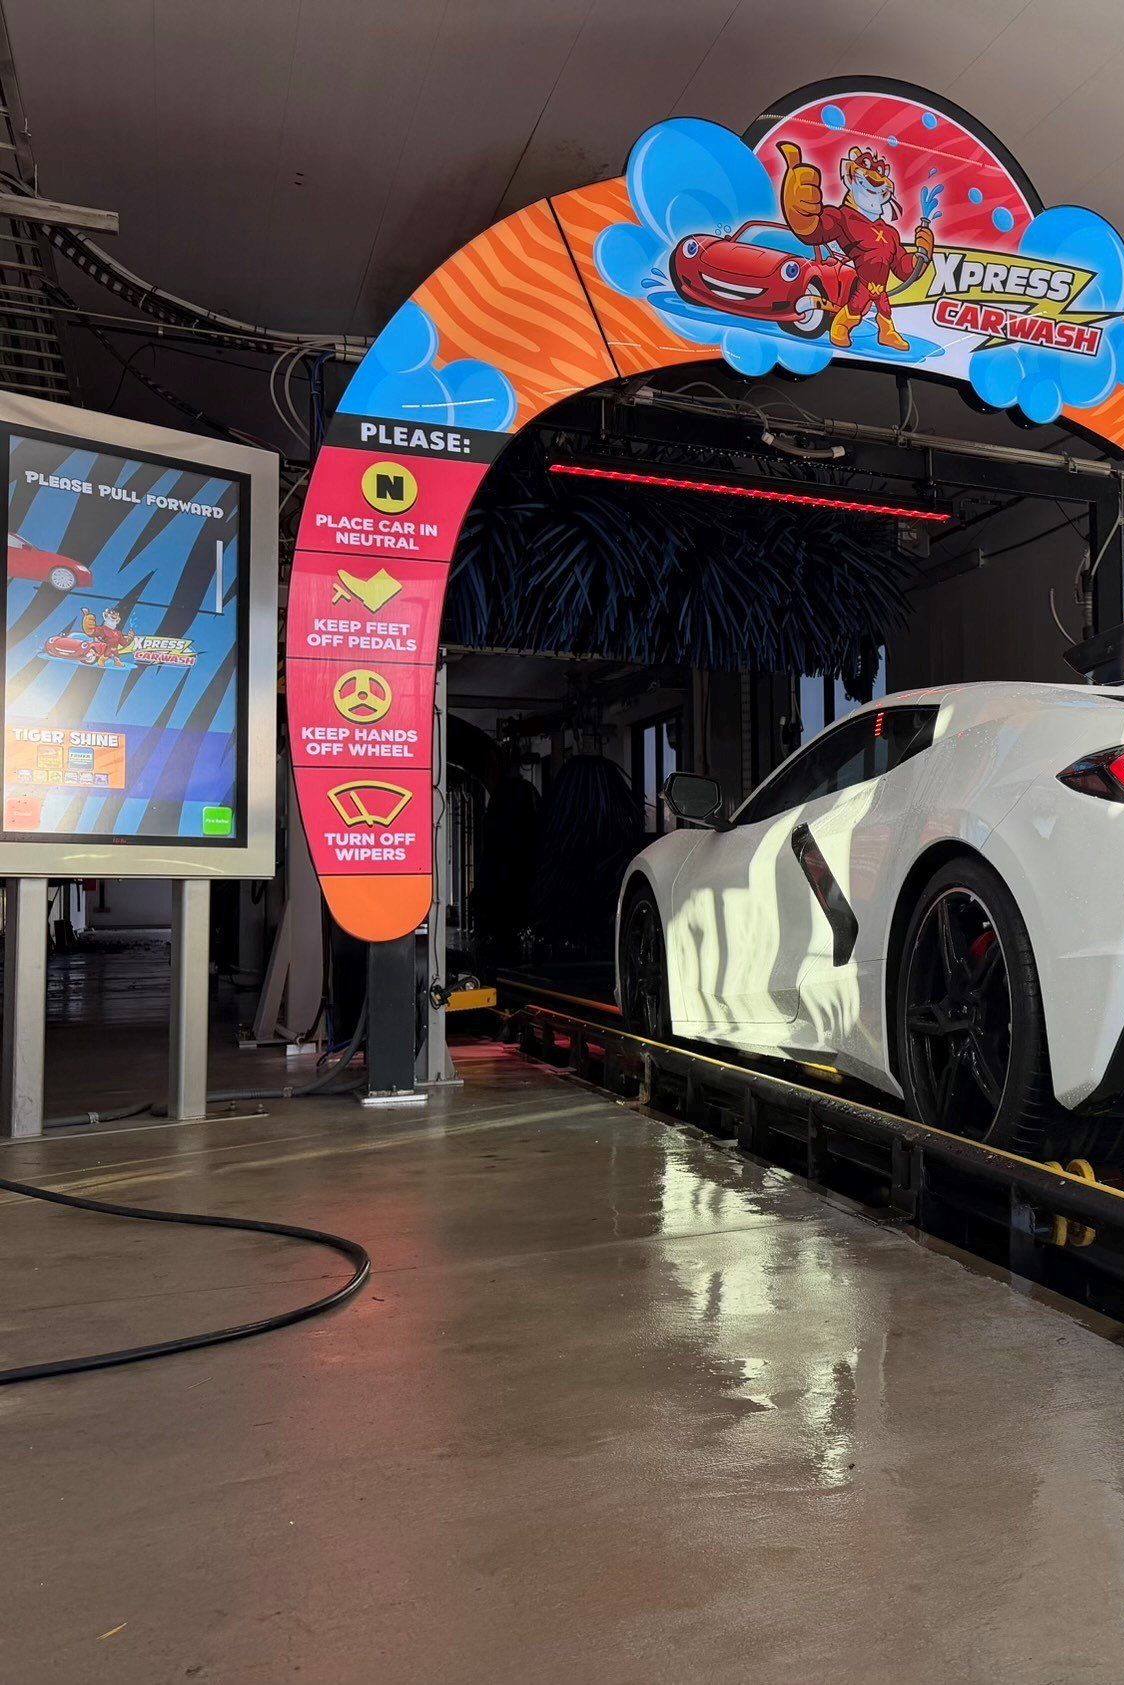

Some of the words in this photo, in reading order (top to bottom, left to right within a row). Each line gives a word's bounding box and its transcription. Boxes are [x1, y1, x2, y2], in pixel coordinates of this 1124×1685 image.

[929, 251, 1075, 302] XPRESS
[935, 299, 1004, 335] CAR
[1006, 312, 1102, 355] WASH
[360, 422, 471, 453] PLEASE:
[25, 470, 93, 495] PLEASE
[98, 484, 141, 504] PULL
[146, 493, 224, 519] FORWARD
[376, 474, 404, 501] N
[316, 513, 374, 531] PLACE
[379, 521, 415, 536] CAR
[419, 523, 438, 537] IN
[336, 531, 420, 551] NEUTRAL
[314, 618, 361, 633] KEEP
[366, 622, 411, 636] FEET
[133, 636, 186, 650] XPRESS
[306, 633, 344, 647] OFF
[348, 636, 418, 651] PEDALS
[13, 728, 66, 744] TIGER
[70, 731, 120, 748] SHINE
[301, 726, 351, 740] KEEP
[354, 728, 418, 742] HANDS
[306, 742, 343, 756] OFF
[348, 743, 414, 757] WHEEL
[324, 832, 375, 846] TURN
[379, 832, 416, 846] OFF
[334, 847, 407, 861] WIPERS
